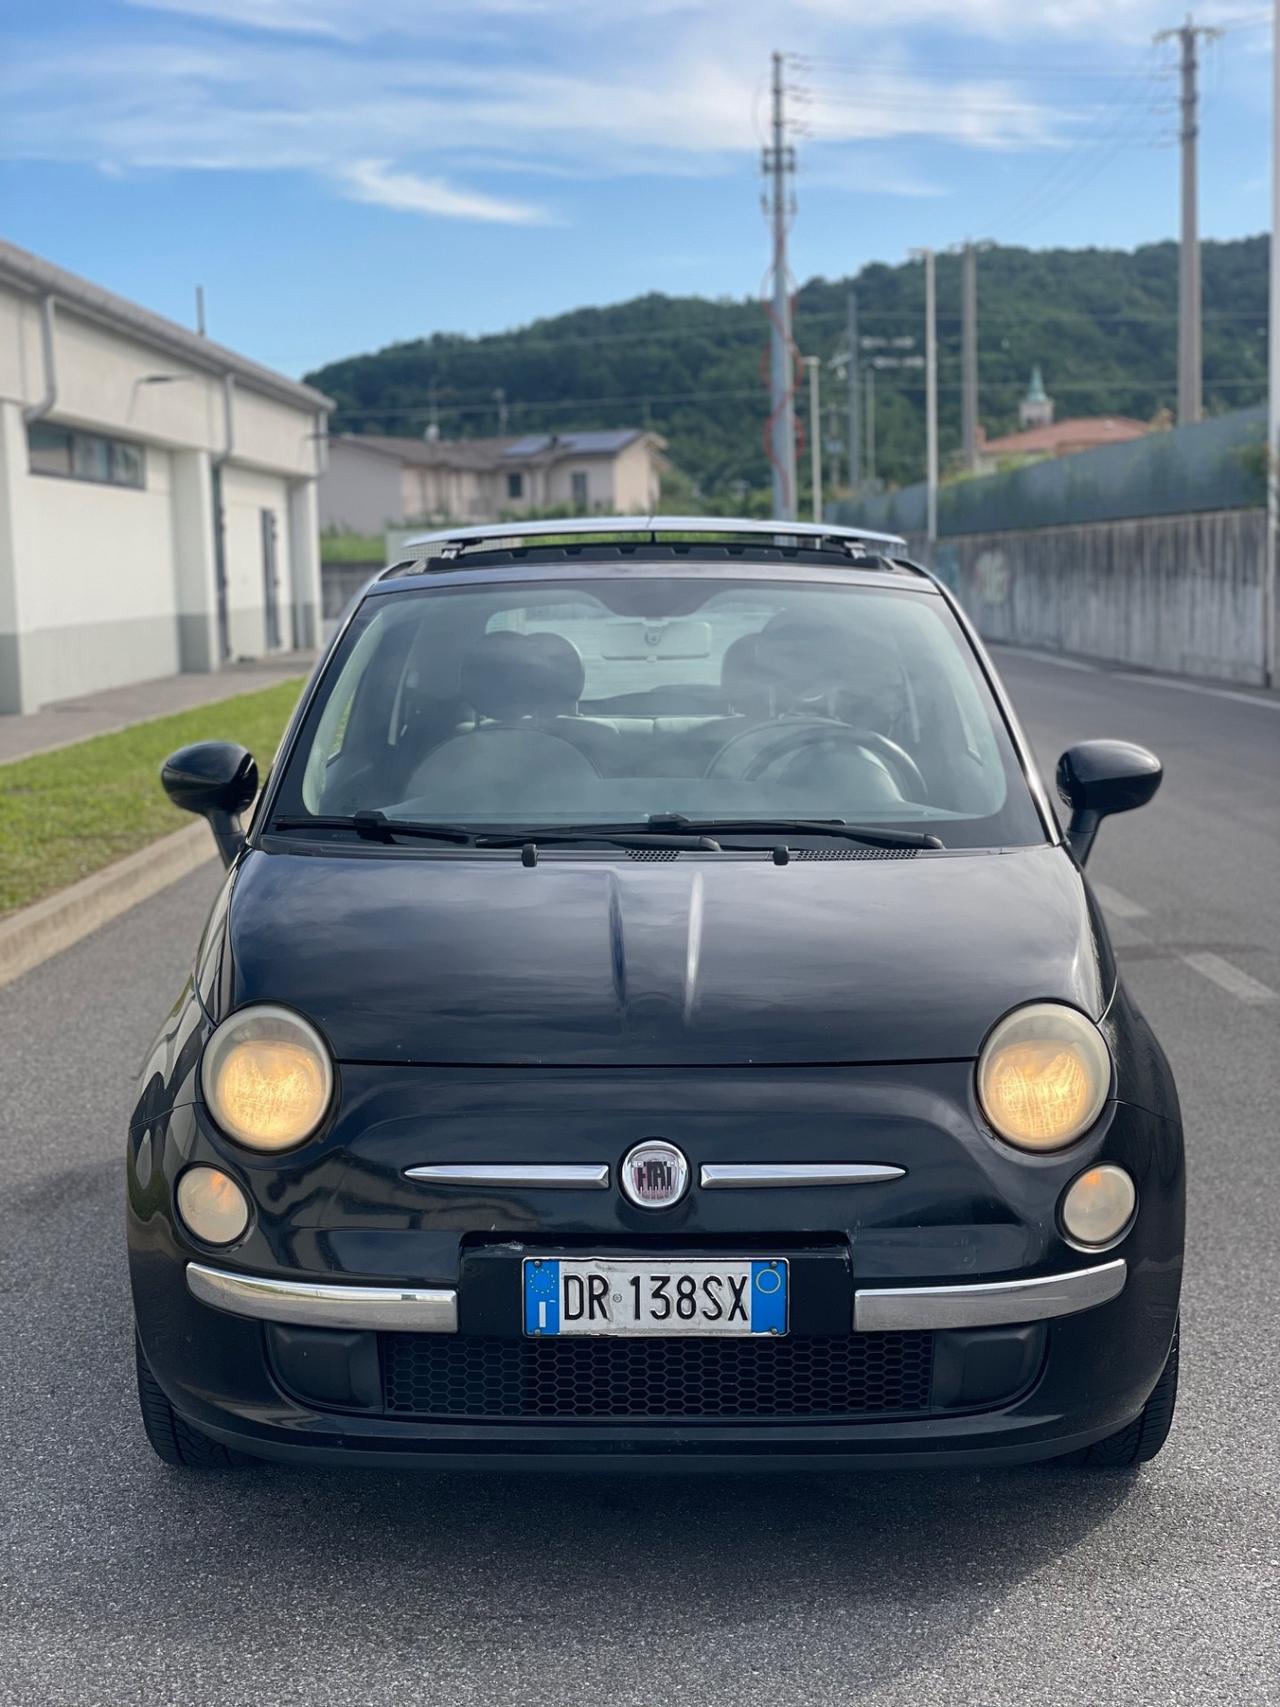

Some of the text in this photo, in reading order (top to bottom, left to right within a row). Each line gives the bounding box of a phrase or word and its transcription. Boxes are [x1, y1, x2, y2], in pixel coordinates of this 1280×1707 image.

[635, 1160, 675, 1191] FIAT
[563, 1274, 749, 1321] DR 138SX
[538, 1301, 547, 1328] I
